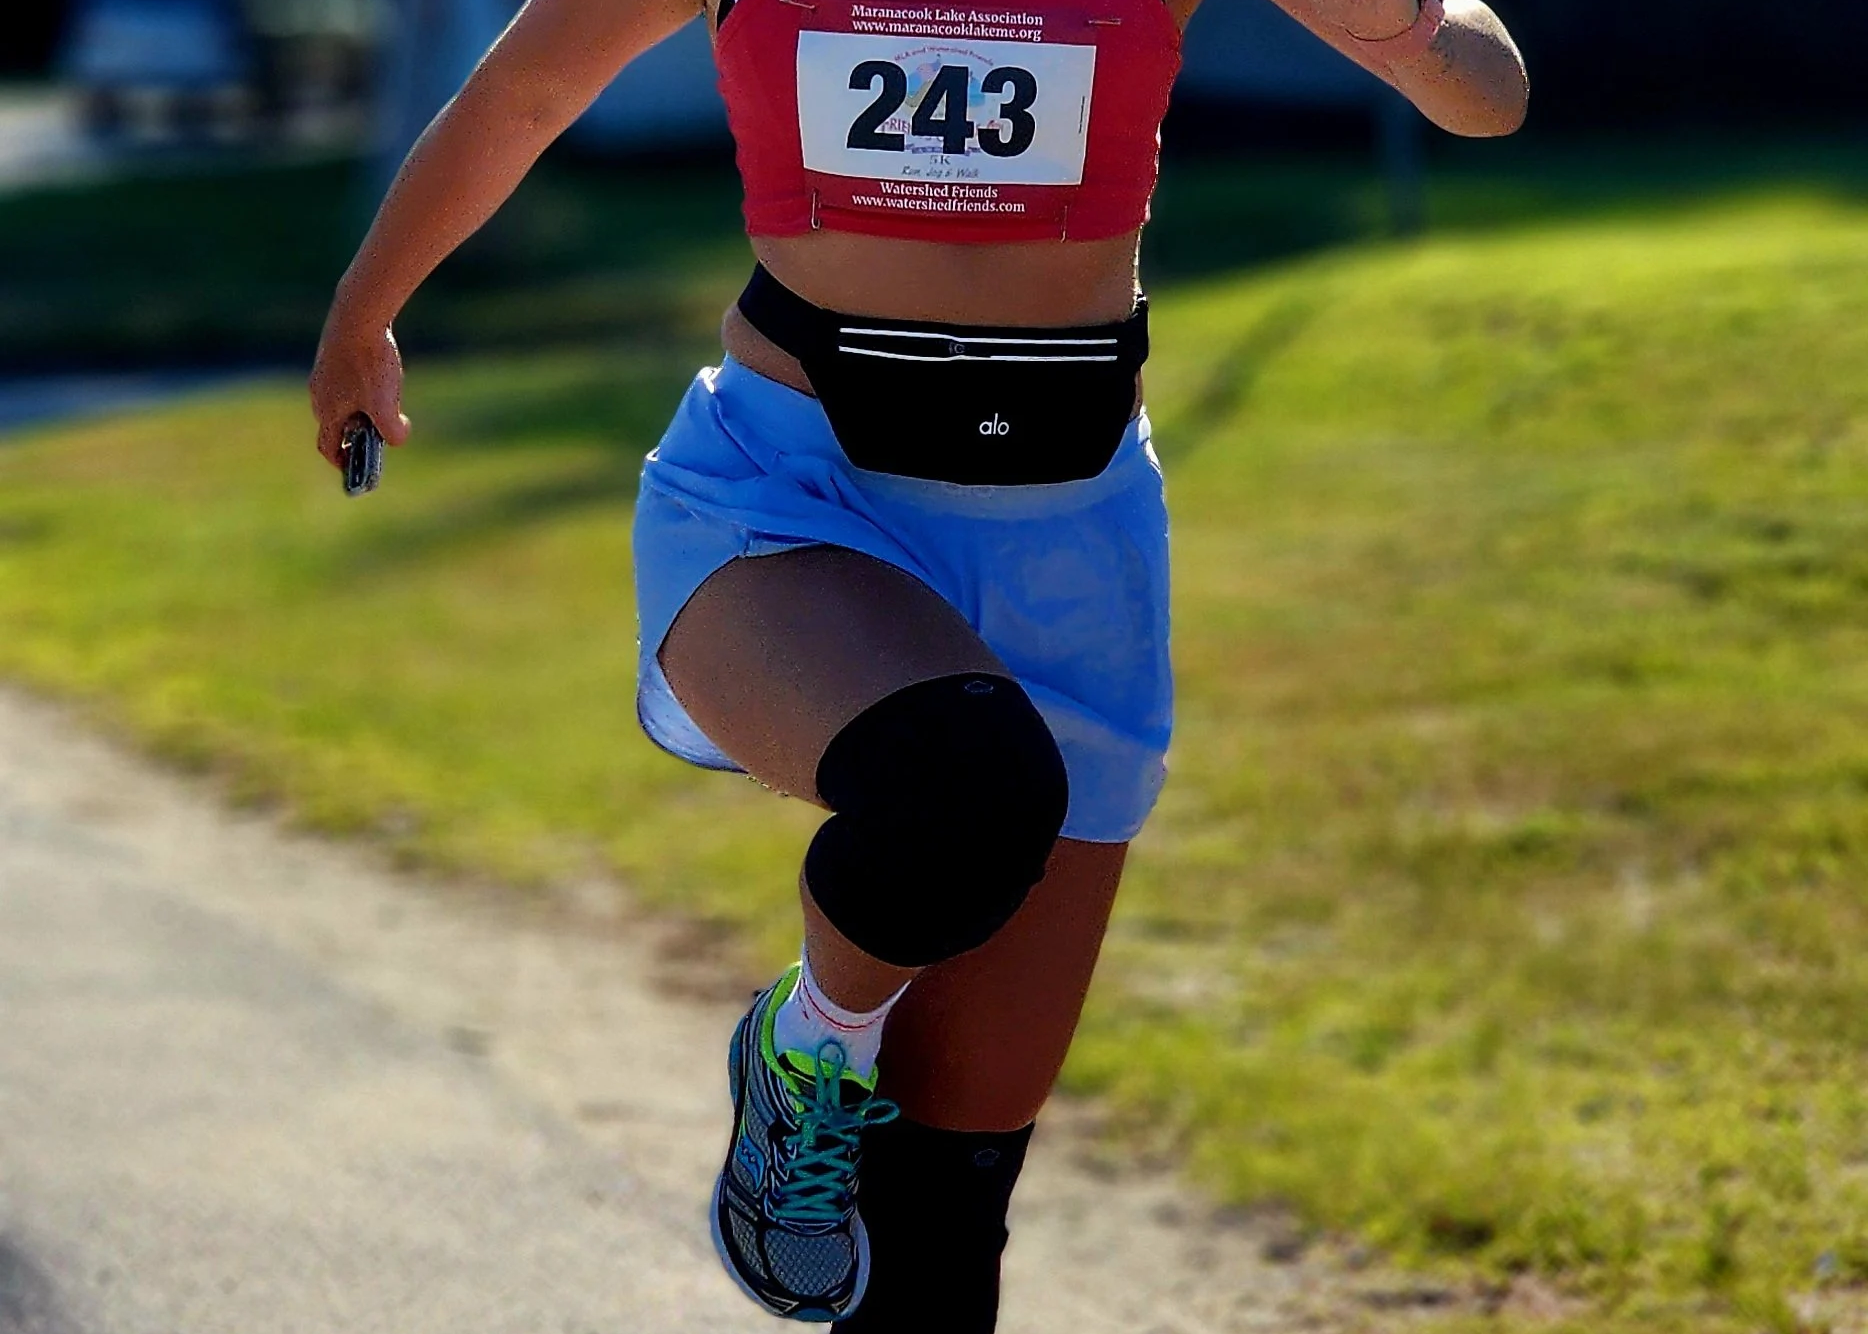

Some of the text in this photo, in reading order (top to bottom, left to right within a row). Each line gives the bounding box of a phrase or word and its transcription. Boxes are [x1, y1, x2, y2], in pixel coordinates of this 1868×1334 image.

[851, 4, 1043, 26] Maranacook Lake Association
[852, 20, 1042, 42] www.maranacooklakeme.org
[847, 60, 1038, 157] 243
[880, 181, 998, 198] Watershed Friends
[852, 195, 1025, 212] www.watershedfriends.com
[979, 412, 1010, 435] alo
